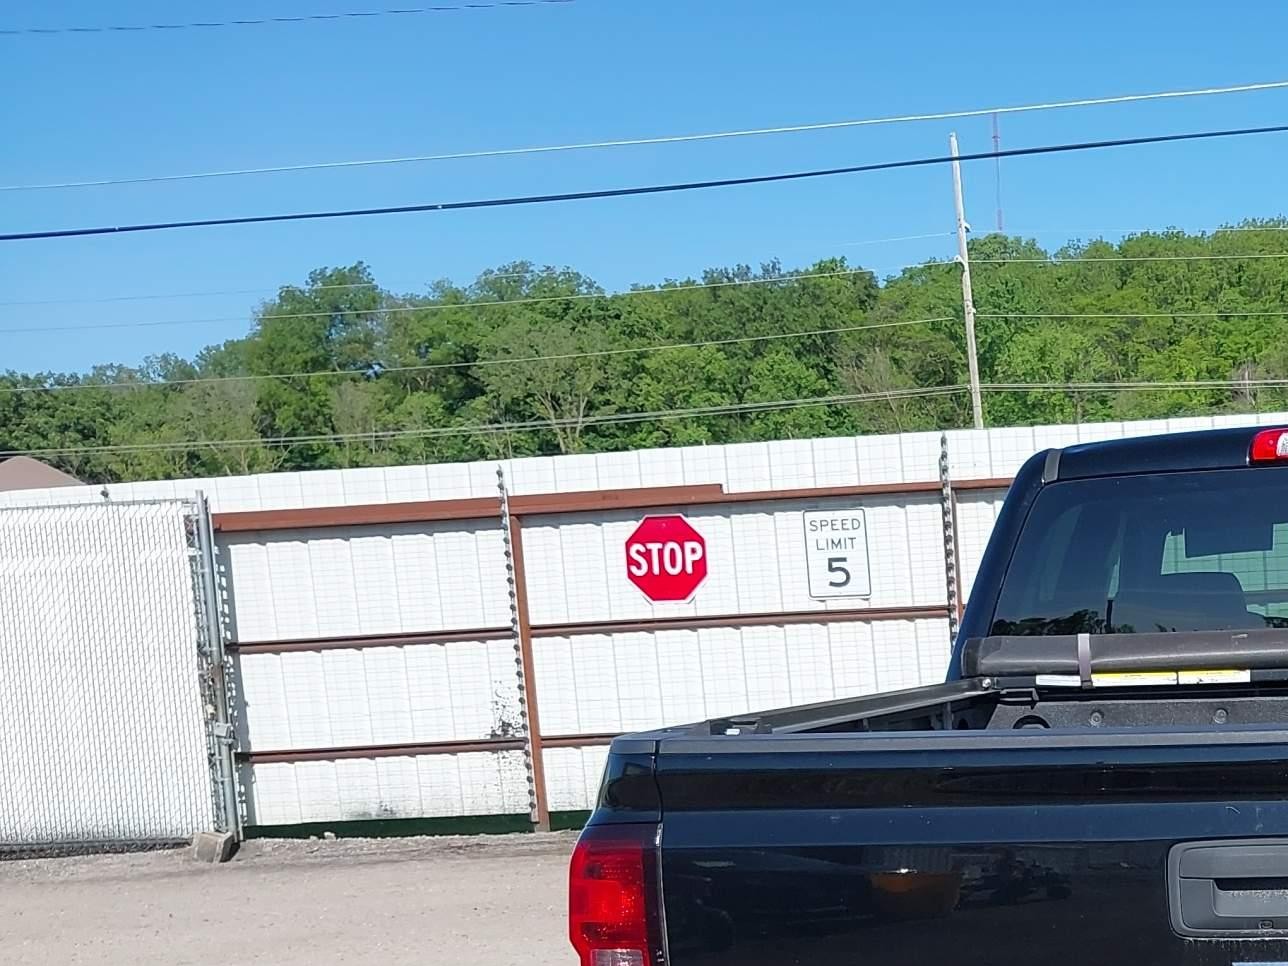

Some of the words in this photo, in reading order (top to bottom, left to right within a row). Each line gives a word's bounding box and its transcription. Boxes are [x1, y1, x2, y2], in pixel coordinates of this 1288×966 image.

[809, 518, 861, 532] SPEED
[815, 537, 857, 551] LIMIT
[629, 541, 704, 577] STOP
[827, 557, 851, 588] 5
